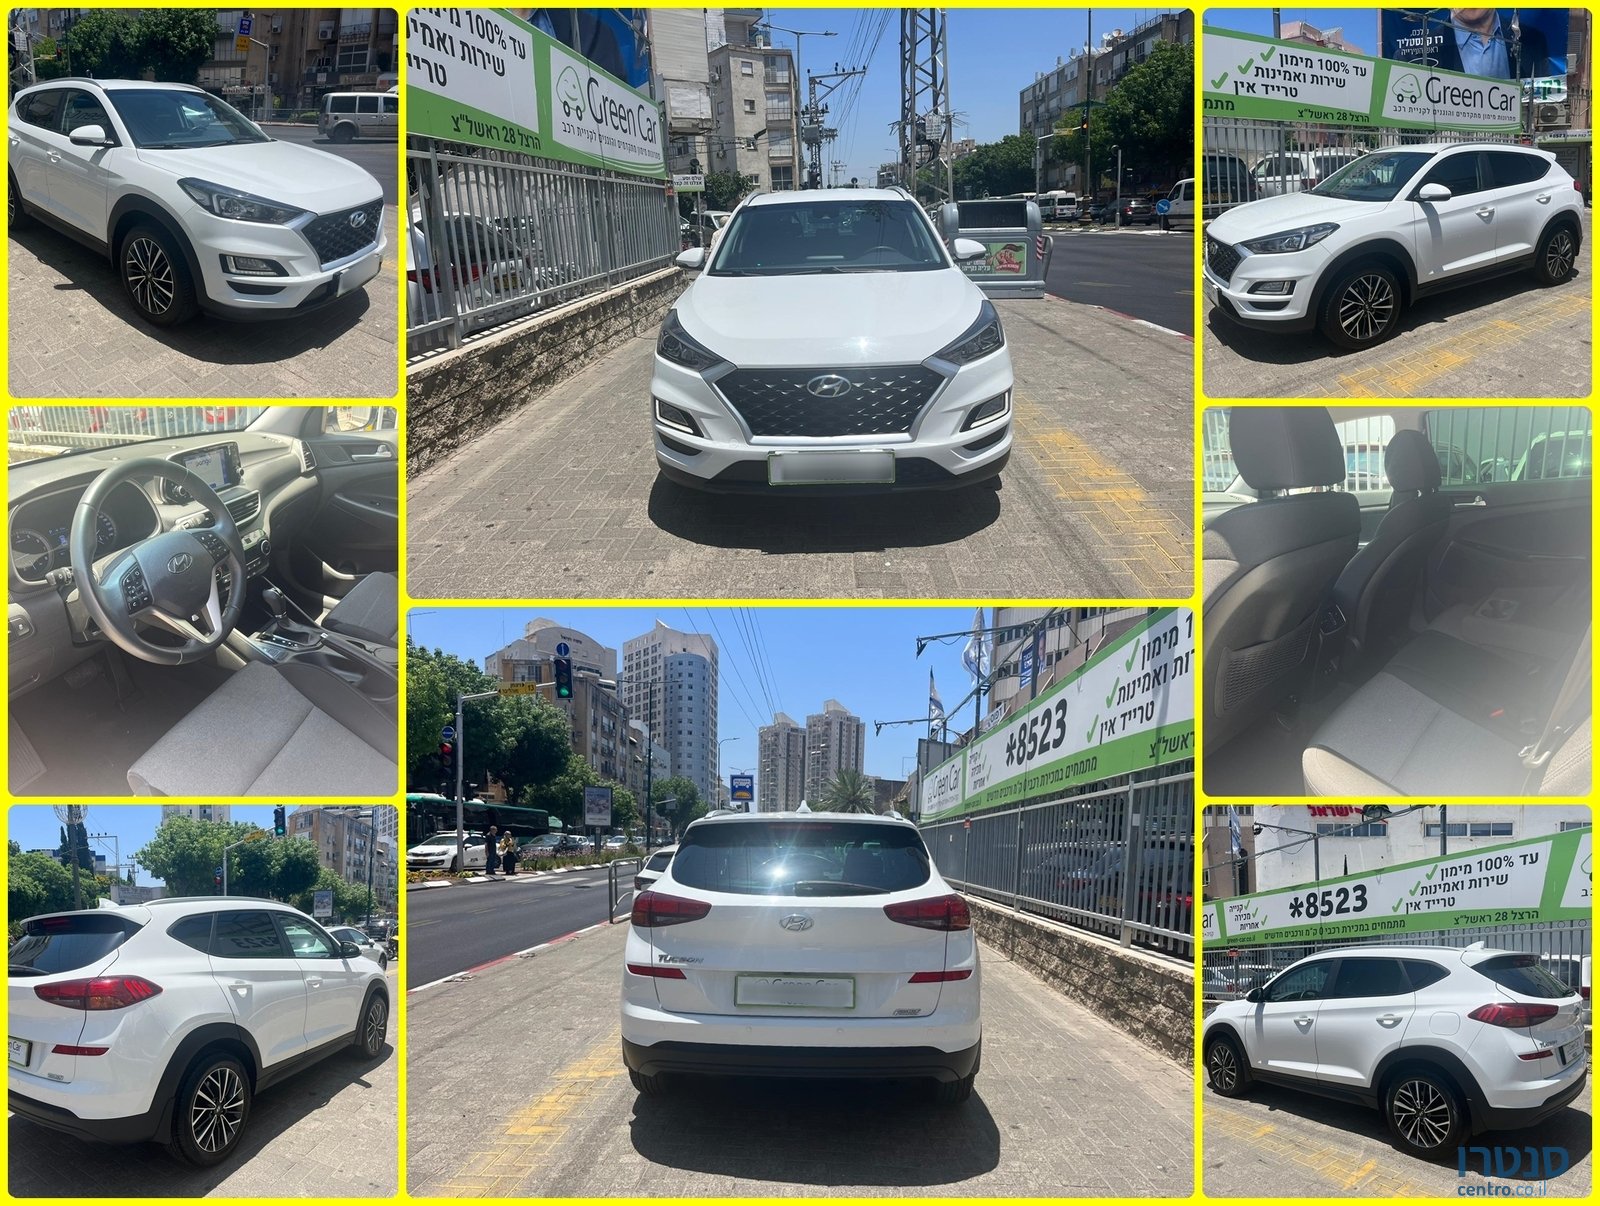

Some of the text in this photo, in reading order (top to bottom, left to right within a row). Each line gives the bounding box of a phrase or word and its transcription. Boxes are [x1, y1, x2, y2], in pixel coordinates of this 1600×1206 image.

[509, 36, 525, 59] עד
[1434, 35, 1443, 44] רז
[460, 40, 505, 76] שירות
[1280, 53, 1367, 77] עד 100% מימון
[1254, 66, 1345, 88] שירות ואמינות
[1234, 80, 1298, 97] טרייד אין
[1426, 77, 1515, 112] Green Car
[587, 77, 656, 144] Green Car
[1337, 112, 1347, 120] 28
[1350, 112, 1369, 122] הרצל
[1409, 106, 1430, 115] לקניית
[502, 126, 516, 144] 28
[562, 122, 575, 135] רכב
[577, 126, 596, 142] לקניית
[518, 129, 540, 150] הרצל
[1142, 625, 1179, 670] מימון
[1117, 663, 1167, 706] ואמינות
[1100, 700, 1154, 745] טרייד אין
[1065, 756, 1097, 778] מתמחים
[1040, 768, 1063, 787] במכירת
[1440, 852, 1539, 881] עד 100% מימון
[1420, 874, 1508, 896] שירות ואמינות
[1229, 904, 1243, 913] קנייה
[1406, 896, 1455, 914] טרייד אין
[1234, 913, 1251, 921] מכירה
[1495, 911, 1507, 921] 28
[1511, 910, 1539, 920] הרצל
[1240, 922, 1259, 931] אחריות
[1325, 926, 1340, 935] רכבי
[1342, 924, 1369, 934] במכירת
[1372, 919, 1406, 930] מתמחים
[1264, 931, 1283, 940] חדשים
[1284, 930, 1304, 938] ורכבים
